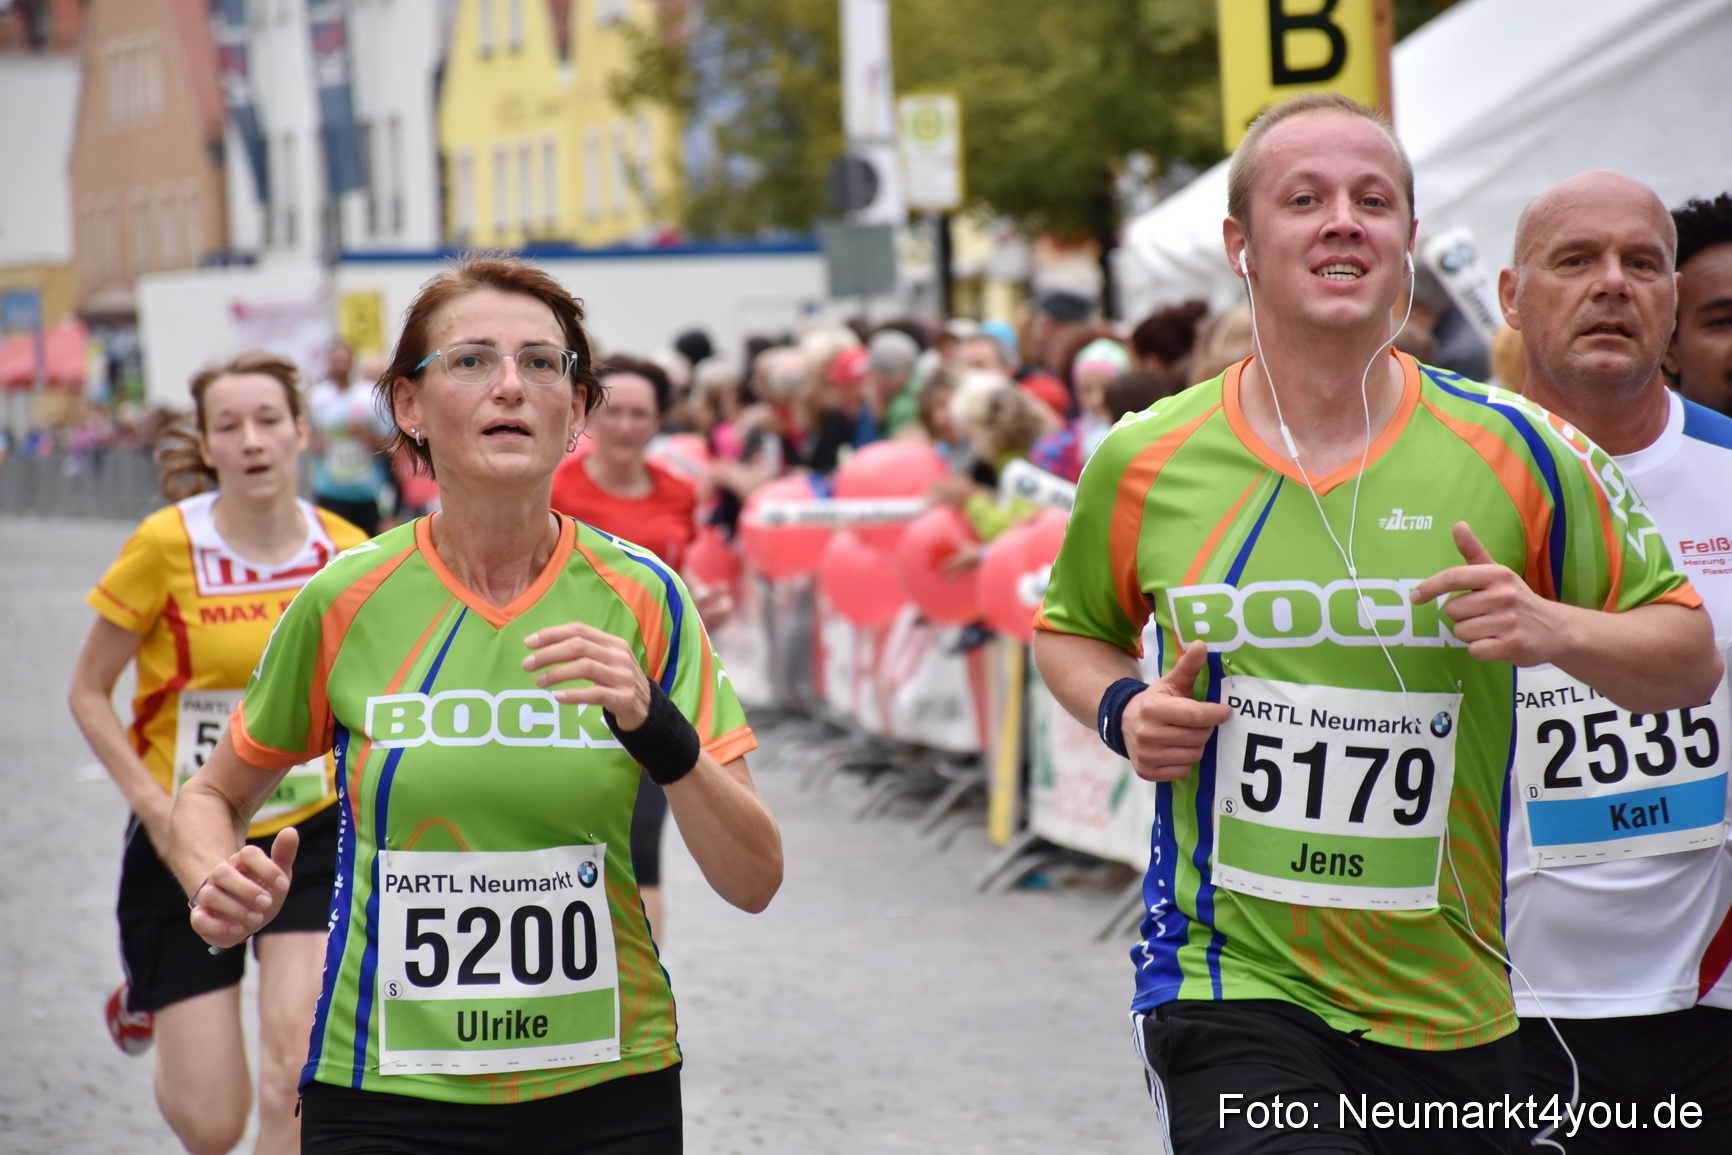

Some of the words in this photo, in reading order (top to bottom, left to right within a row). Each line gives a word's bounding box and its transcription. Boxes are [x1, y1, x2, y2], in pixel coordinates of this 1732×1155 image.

[1679, 537, 1732, 554] Felß
[200, 603, 269, 625] MAX
[1228, 695, 1303, 726] PARTL
[1310, 709, 1421, 734] Neumarkt
[1516, 686, 1584, 709] PARTL
[365, 689, 626, 750] BOCK
[1537, 700, 1720, 790] 2535
[1241, 732, 1435, 826] 5179
[1529, 787, 1538, 799] D
[1225, 800, 1233, 814] S
[1610, 797, 1670, 831] Karl
[1291, 843, 1364, 878] Jens
[385, 874, 463, 893] PARTL
[470, 871, 573, 893] Neumarkt
[405, 900, 598, 988] 5200
[389, 982, 397, 997] S
[457, 1009, 548, 1043] Ulrike
